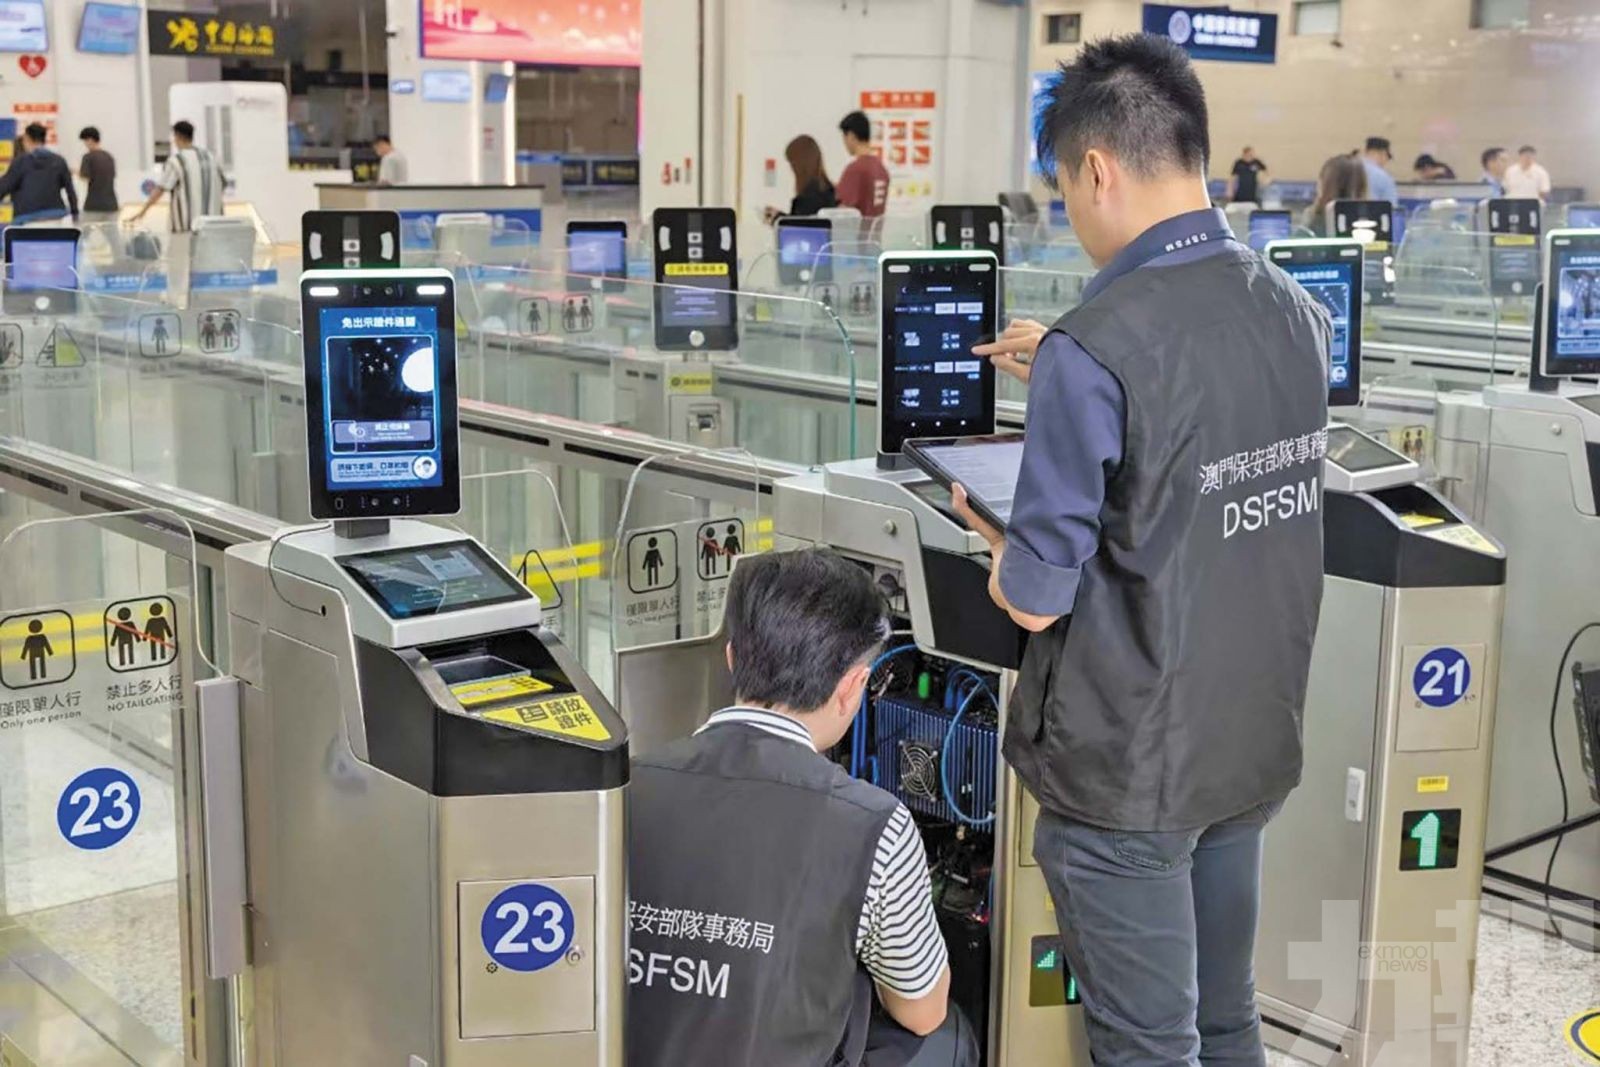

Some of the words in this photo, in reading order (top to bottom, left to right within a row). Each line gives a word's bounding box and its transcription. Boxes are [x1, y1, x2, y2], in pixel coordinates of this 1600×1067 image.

[1223, 476, 1318, 539] DSFSM
[105, 674, 182, 701] 禁止多人行
[1418, 658, 1466, 697] 21
[107, 701, 125, 712] NO
[125, 693, 184, 709] TAILGATING
[545, 697, 585, 716] 請放
[0, 719, 25, 730] Only
[27, 715, 46, 725] one
[47, 710, 82, 724] person
[554, 713, 592, 730] 證件
[69, 780, 134, 838] 23
[494, 900, 566, 954] 23
